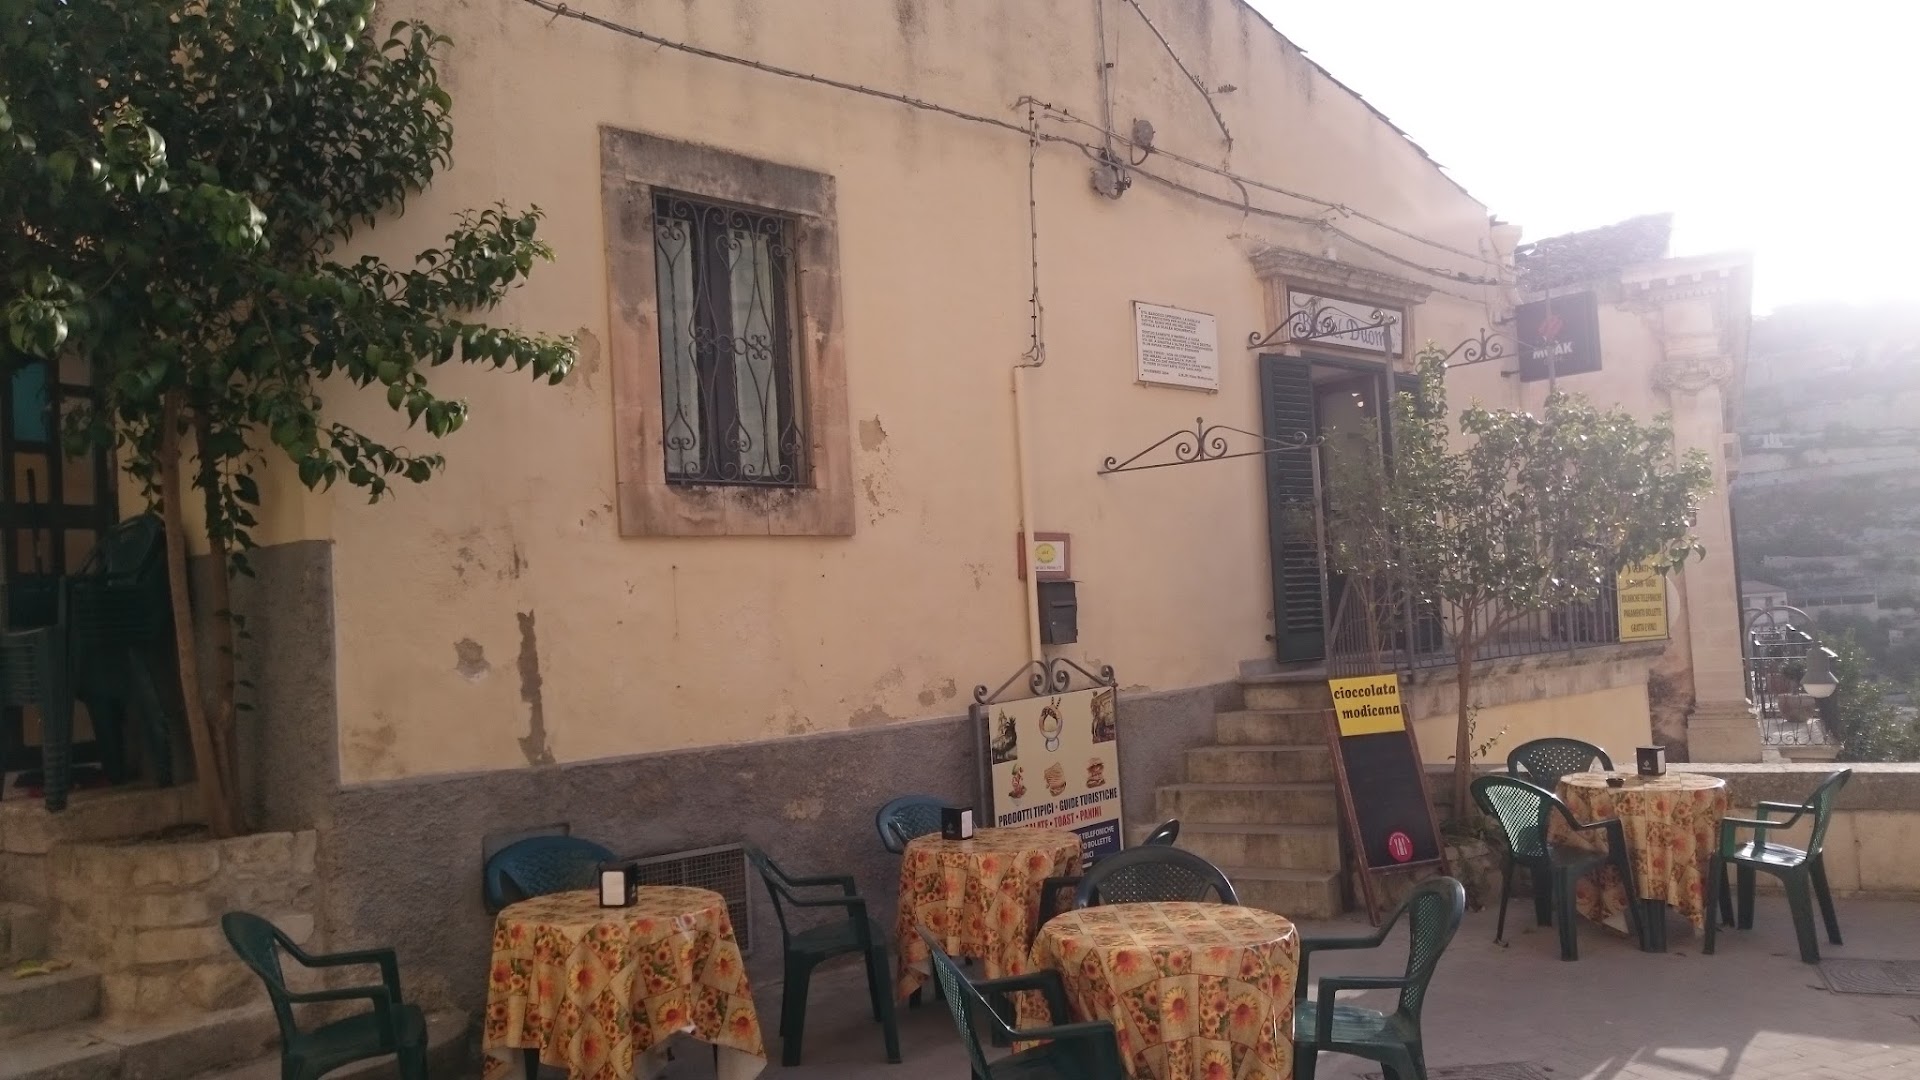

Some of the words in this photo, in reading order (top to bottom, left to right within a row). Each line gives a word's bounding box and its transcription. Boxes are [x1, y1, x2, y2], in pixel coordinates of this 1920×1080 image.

[1334, 684, 1396, 699] cioccolata
[1342, 704, 1400, 719] modicana
[998, 808, 1032, 827] PRODOTTI
[1033, 803, 1054, 817] TIPICI
[1060, 796, 1079, 811] GUIDE
[1080, 787, 1118, 806] TURISTICHE
[1054, 812, 1075, 828] TOAST
[1080, 806, 1102, 821] PANINI
[1082, 825, 1115, 840] TELEFONICHE
[1087, 836, 1112, 849] BOLLETTE
